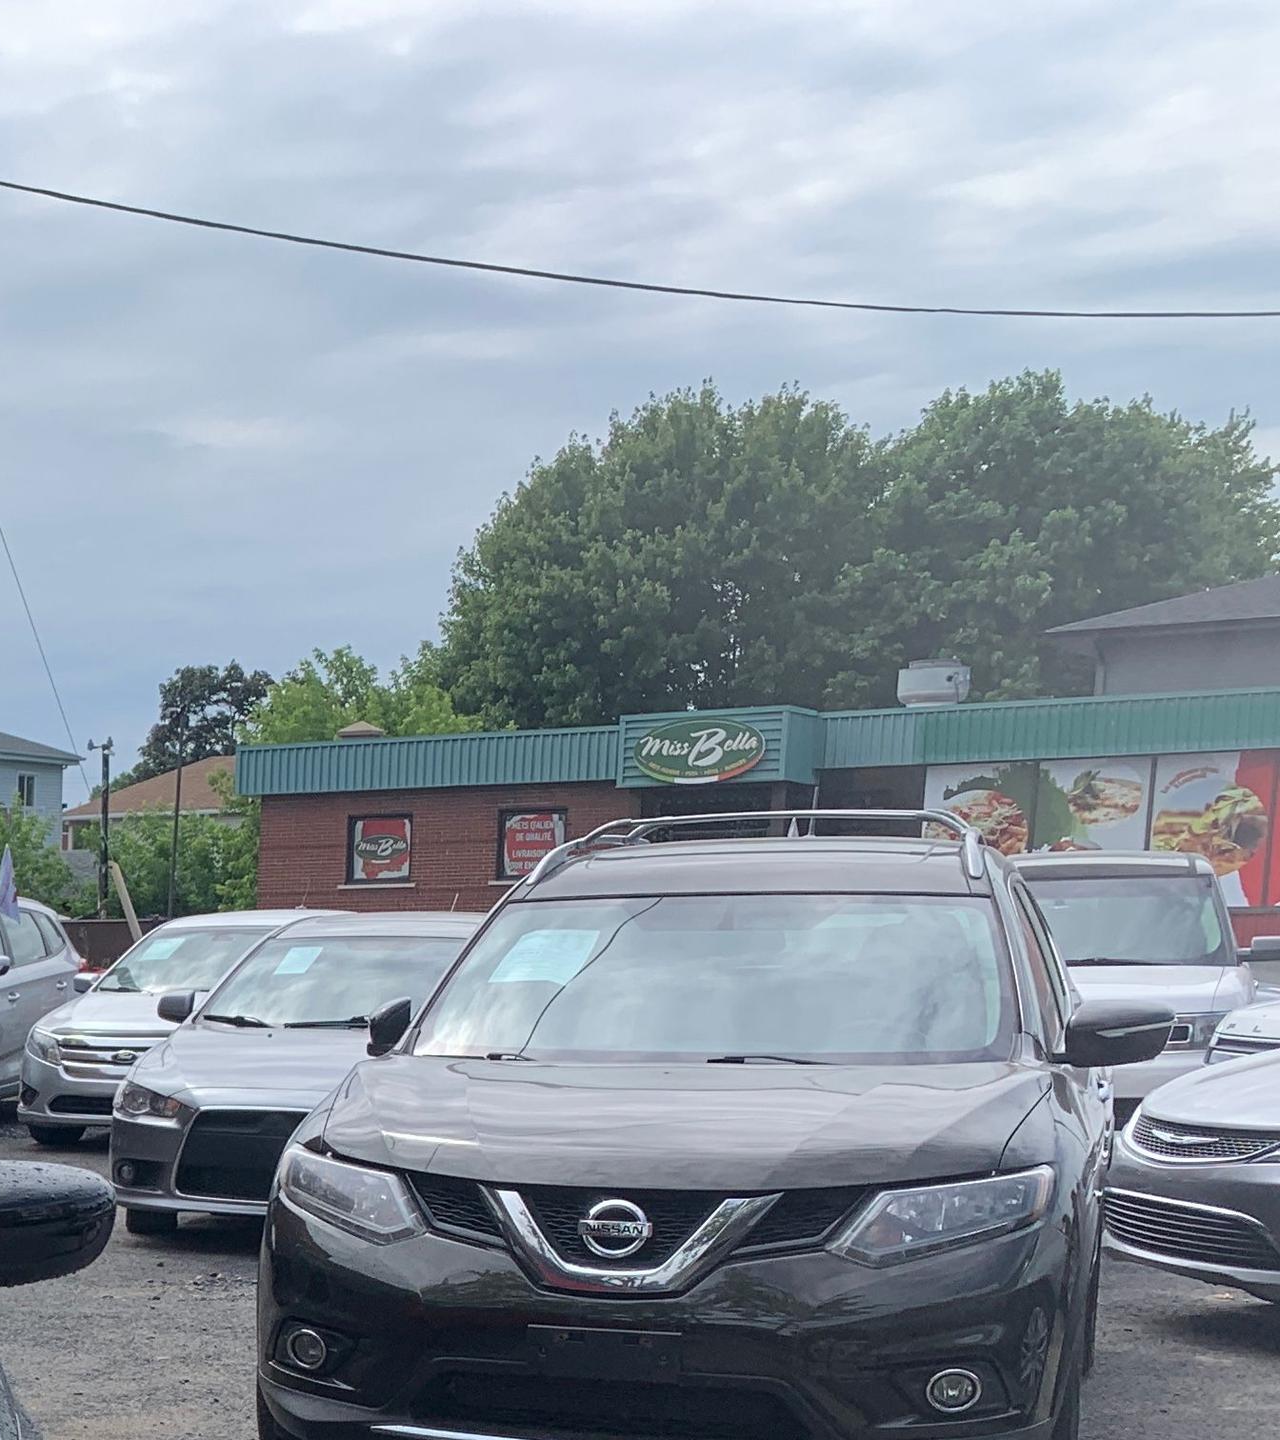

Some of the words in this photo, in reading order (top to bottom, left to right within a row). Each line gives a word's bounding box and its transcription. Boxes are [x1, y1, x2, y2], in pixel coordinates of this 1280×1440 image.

[639, 736, 691, 757] Miss
[687, 728, 759, 767] Bella
[585, 1223, 645, 1236] NISSAN
